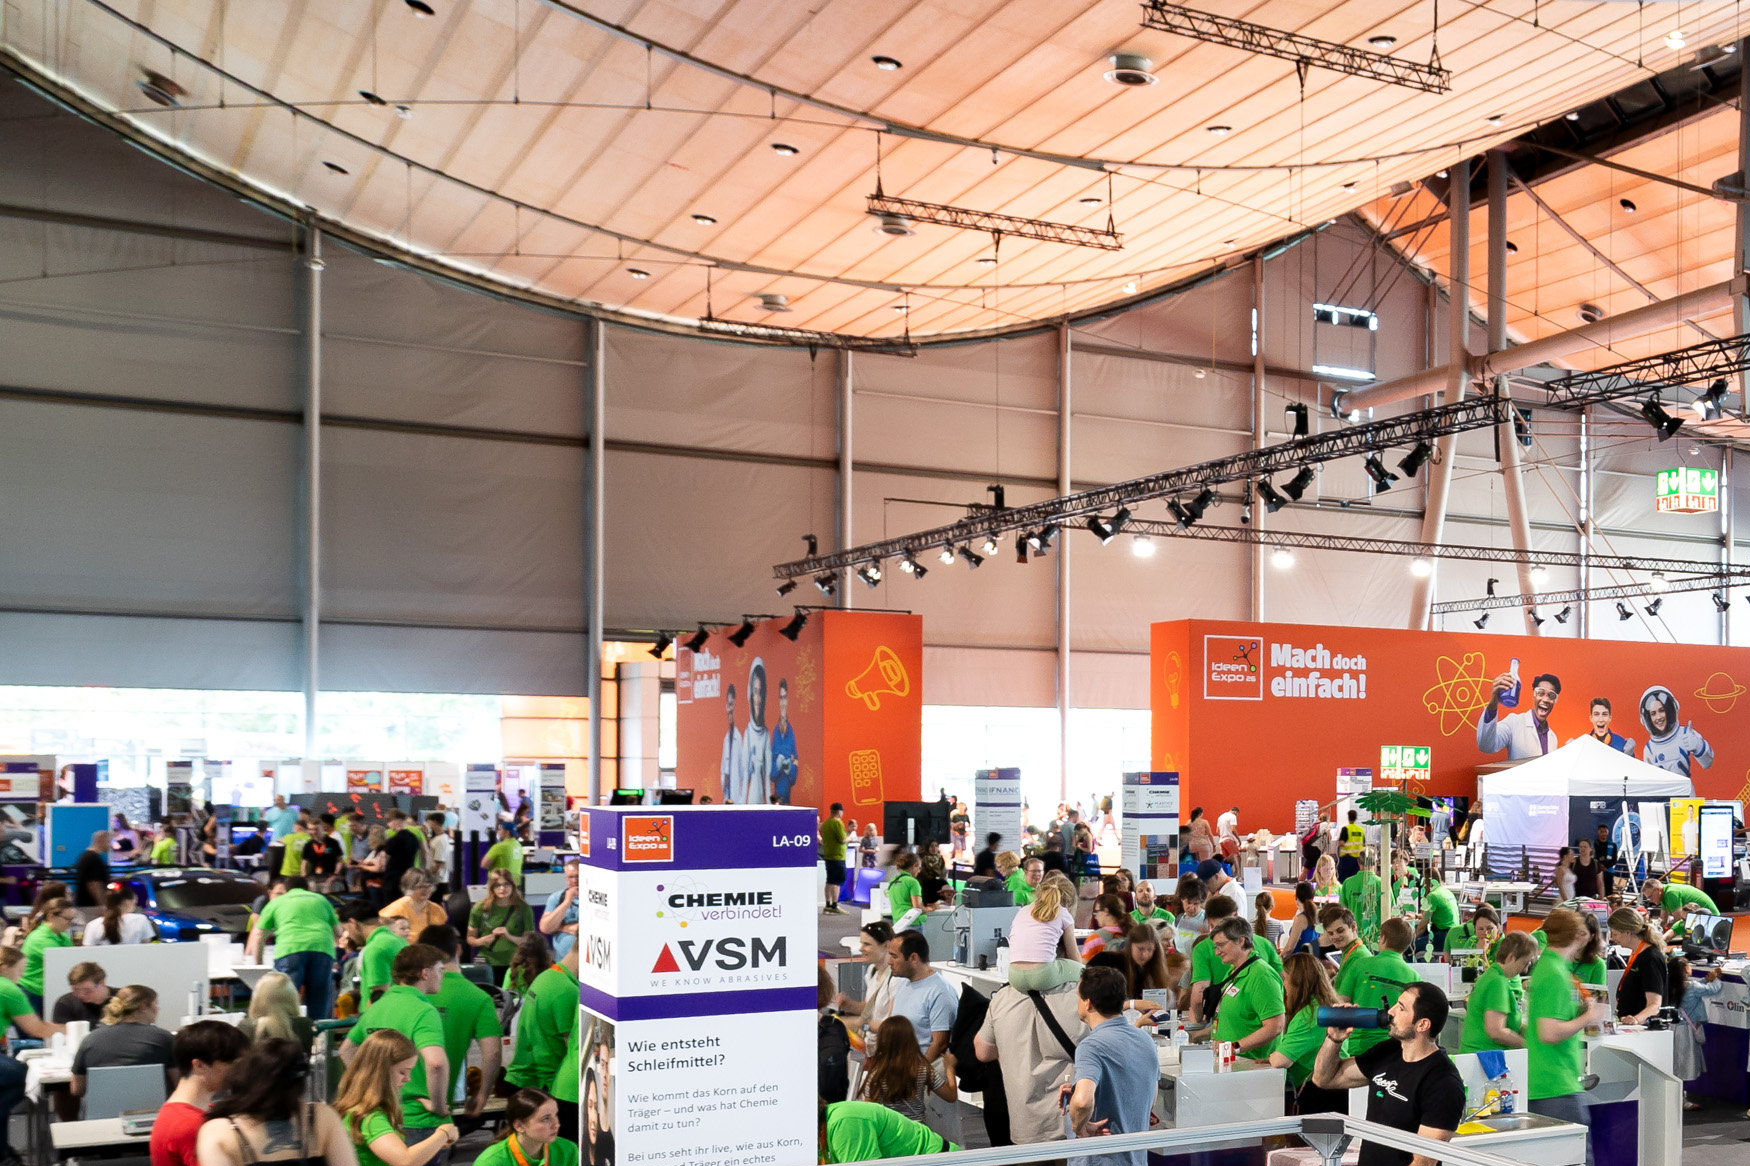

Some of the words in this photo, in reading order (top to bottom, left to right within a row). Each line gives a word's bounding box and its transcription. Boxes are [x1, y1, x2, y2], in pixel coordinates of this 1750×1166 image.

[1271, 643, 1331, 668] Mach
[1332, 654, 1367, 671] doch
[1211, 662, 1247, 672] Ideen
[1211, 672, 1244, 682] Expo
[1270, 670, 1367, 699] einfach!
[628, 834, 661, 843] Ideen
[628, 842, 657, 850] Expo
[772, 835, 811, 847] LA-09
[668, 891, 773, 908] CHEMIE
[701, 905, 782, 921] verbindet!
[677, 936, 787, 971] VSM
[650, 979, 667, 987] WE
[675, 977, 711, 986] KNOW
[719, 973, 788, 984] ABRASIVES
[628, 1040, 656, 1052] Wie
[661, 1035, 721, 1051] entsteht
[628, 1053, 726, 1073] Schleifmittel?
[628, 1093, 649, 1104] Wie
[652, 1090, 690, 1102] kommt
[692, 1088, 710, 1098] das
[713, 1086, 737, 1097] Korn
[740, 1083, 758, 1095] auf
[760, 1083, 779, 1093] den
[628, 1107, 661, 1121] Träger
[674, 1104, 694, 1115] und
[696, 1104, 718, 1113] was
[720, 1100, 737, 1111] hat
[739, 1097, 779, 1109] Chemie
[628, 1121, 659, 1133] damit
[662, 1121, 674, 1130] zu
[677, 1118, 701, 1129] tun?
[628, 1152, 645, 1163] Bei
[647, 1152, 667, 1161] uns
[669, 1148, 692, 1159] seht
[694, 1145, 709, 1157] ihr
[711, 1144, 733, 1156] live,
[736, 1141, 754, 1151] wie
[757, 1140, 774, 1149] aus
[777, 1137, 803, 1149] Korn,
[724, 1157, 740, 1166] ein
[742, 1154, 776, 1165] echtes
